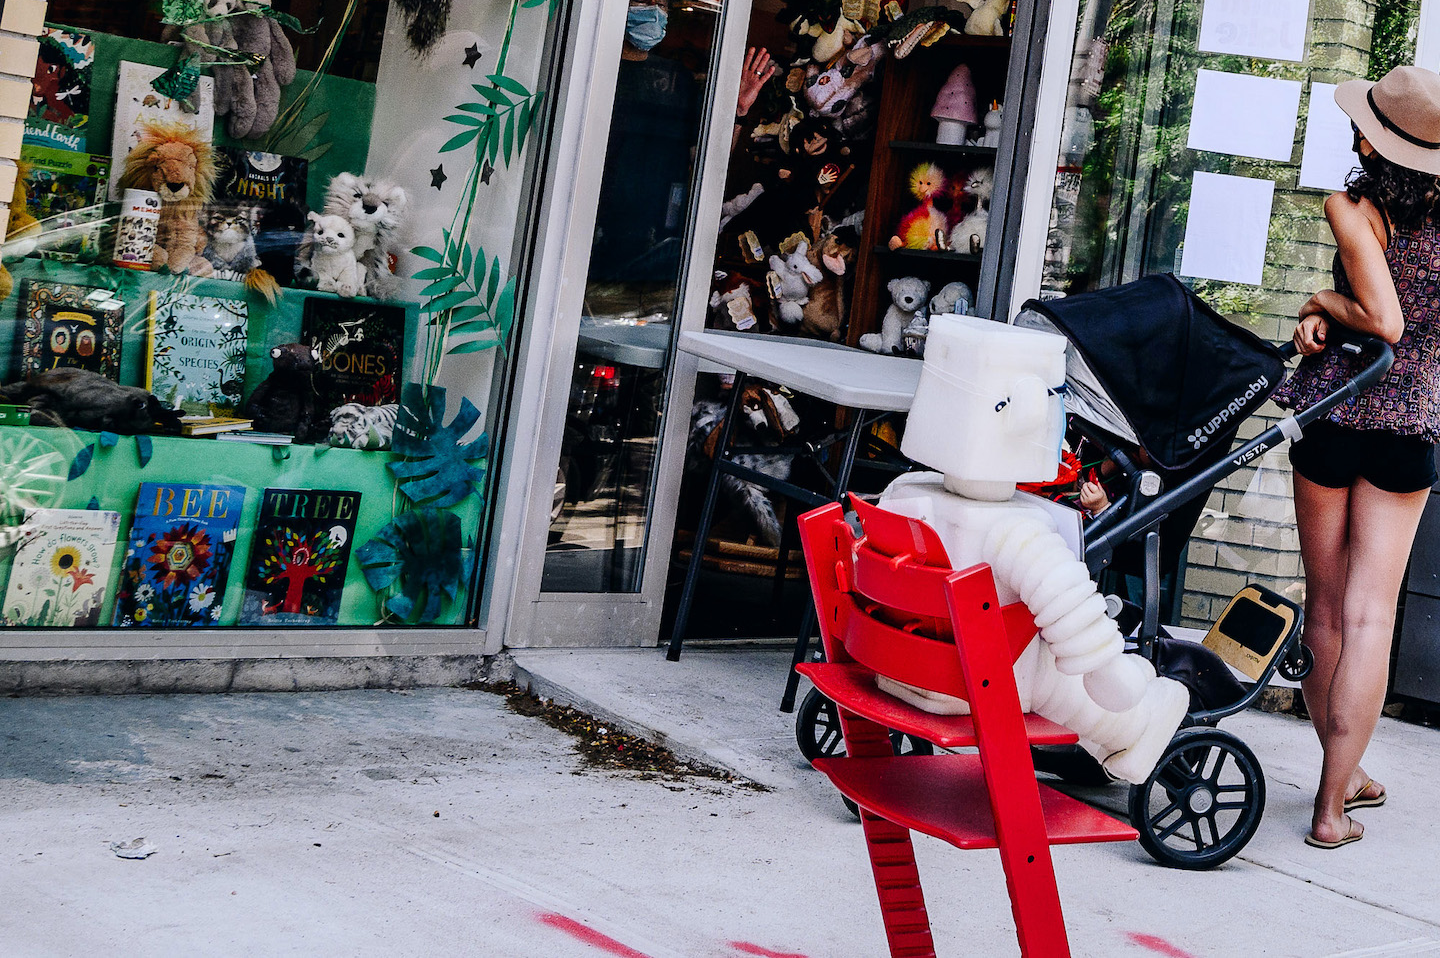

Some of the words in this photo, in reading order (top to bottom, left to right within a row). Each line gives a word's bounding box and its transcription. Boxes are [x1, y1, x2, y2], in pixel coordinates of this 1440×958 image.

[23, 123, 50, 138] iend
[51, 125, 80, 151] Earth
[48, 158, 73, 169] Puzzle
[237, 177, 287, 200] NIGHT
[181, 336, 216, 348] ORIGIN
[179, 357, 219, 370] SPECIES
[322, 350, 386, 376] BONES
[1204, 374, 1269, 436] UPPAbaby
[1233, 442, 1268, 467] VISTA
[152, 487, 231, 519] BEE
[270, 493, 355, 520] TREE
[31, 547, 46, 565] How
[47, 539, 57, 548] do
[60, 533, 89, 547] flowers
[87, 543, 100, 569] grow?
